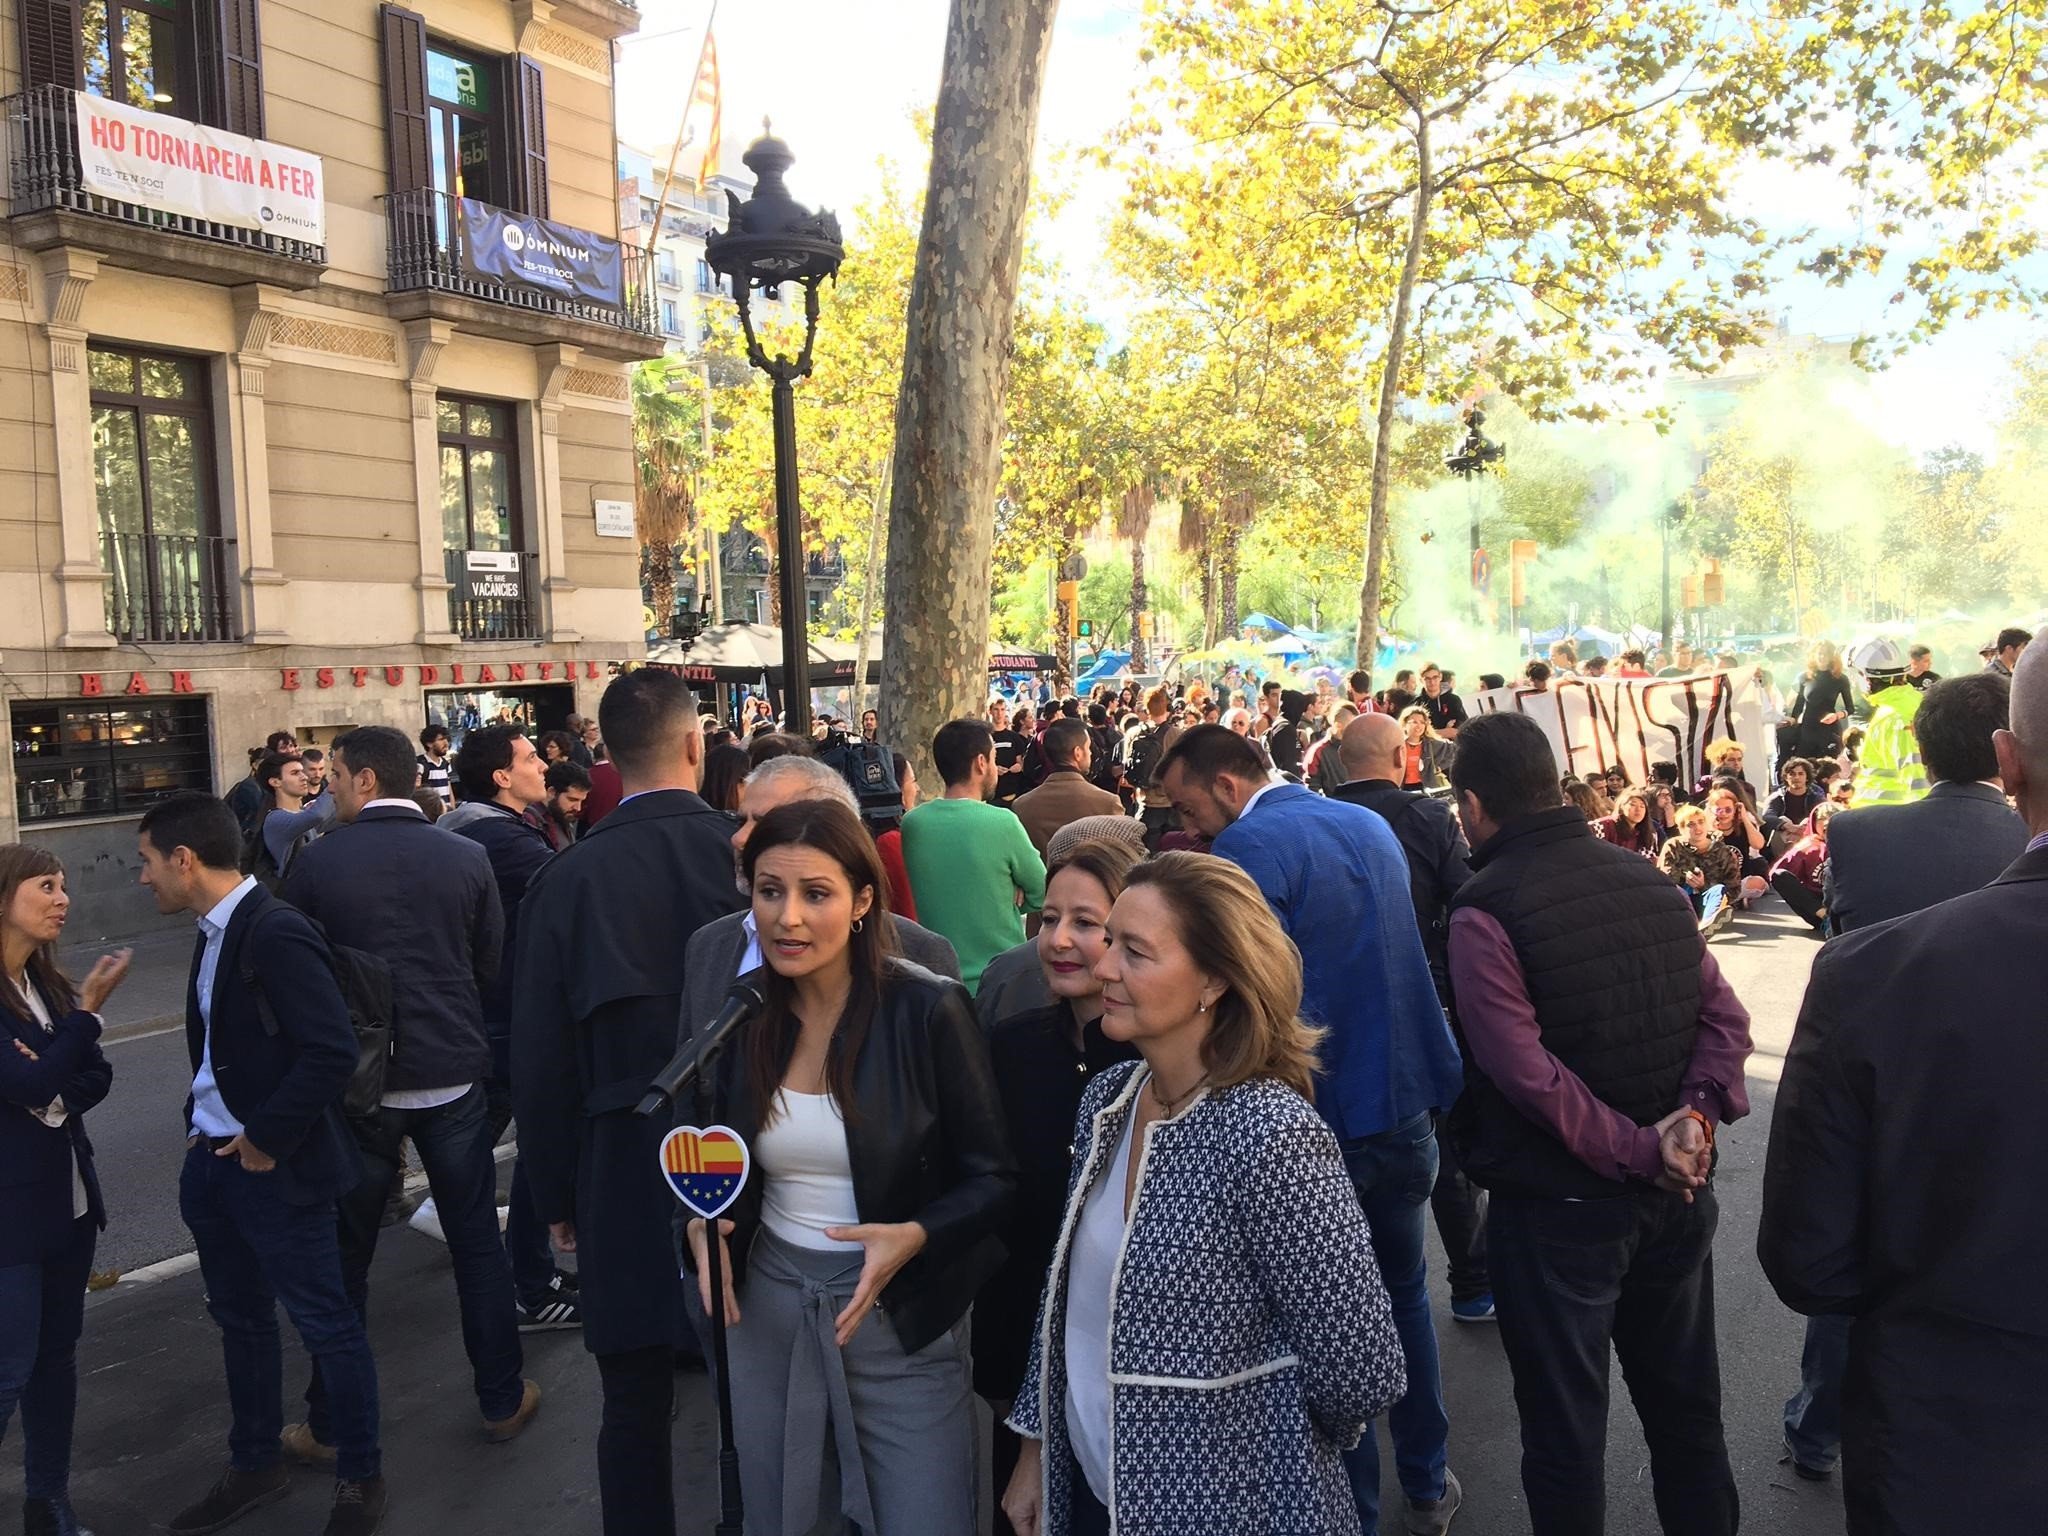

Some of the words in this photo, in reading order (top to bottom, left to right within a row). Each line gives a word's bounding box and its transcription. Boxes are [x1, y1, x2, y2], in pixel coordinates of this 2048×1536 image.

[91, 116, 125, 152] HO
[130, 124, 254, 185] TORNAREM
[260, 159, 274, 189] A
[278, 163, 315, 200] FER
[471, 582, 519, 597] VACANCIES
[79, 671, 194, 696] BAR
[280, 660, 599, 690] ESTUDIANTIL
